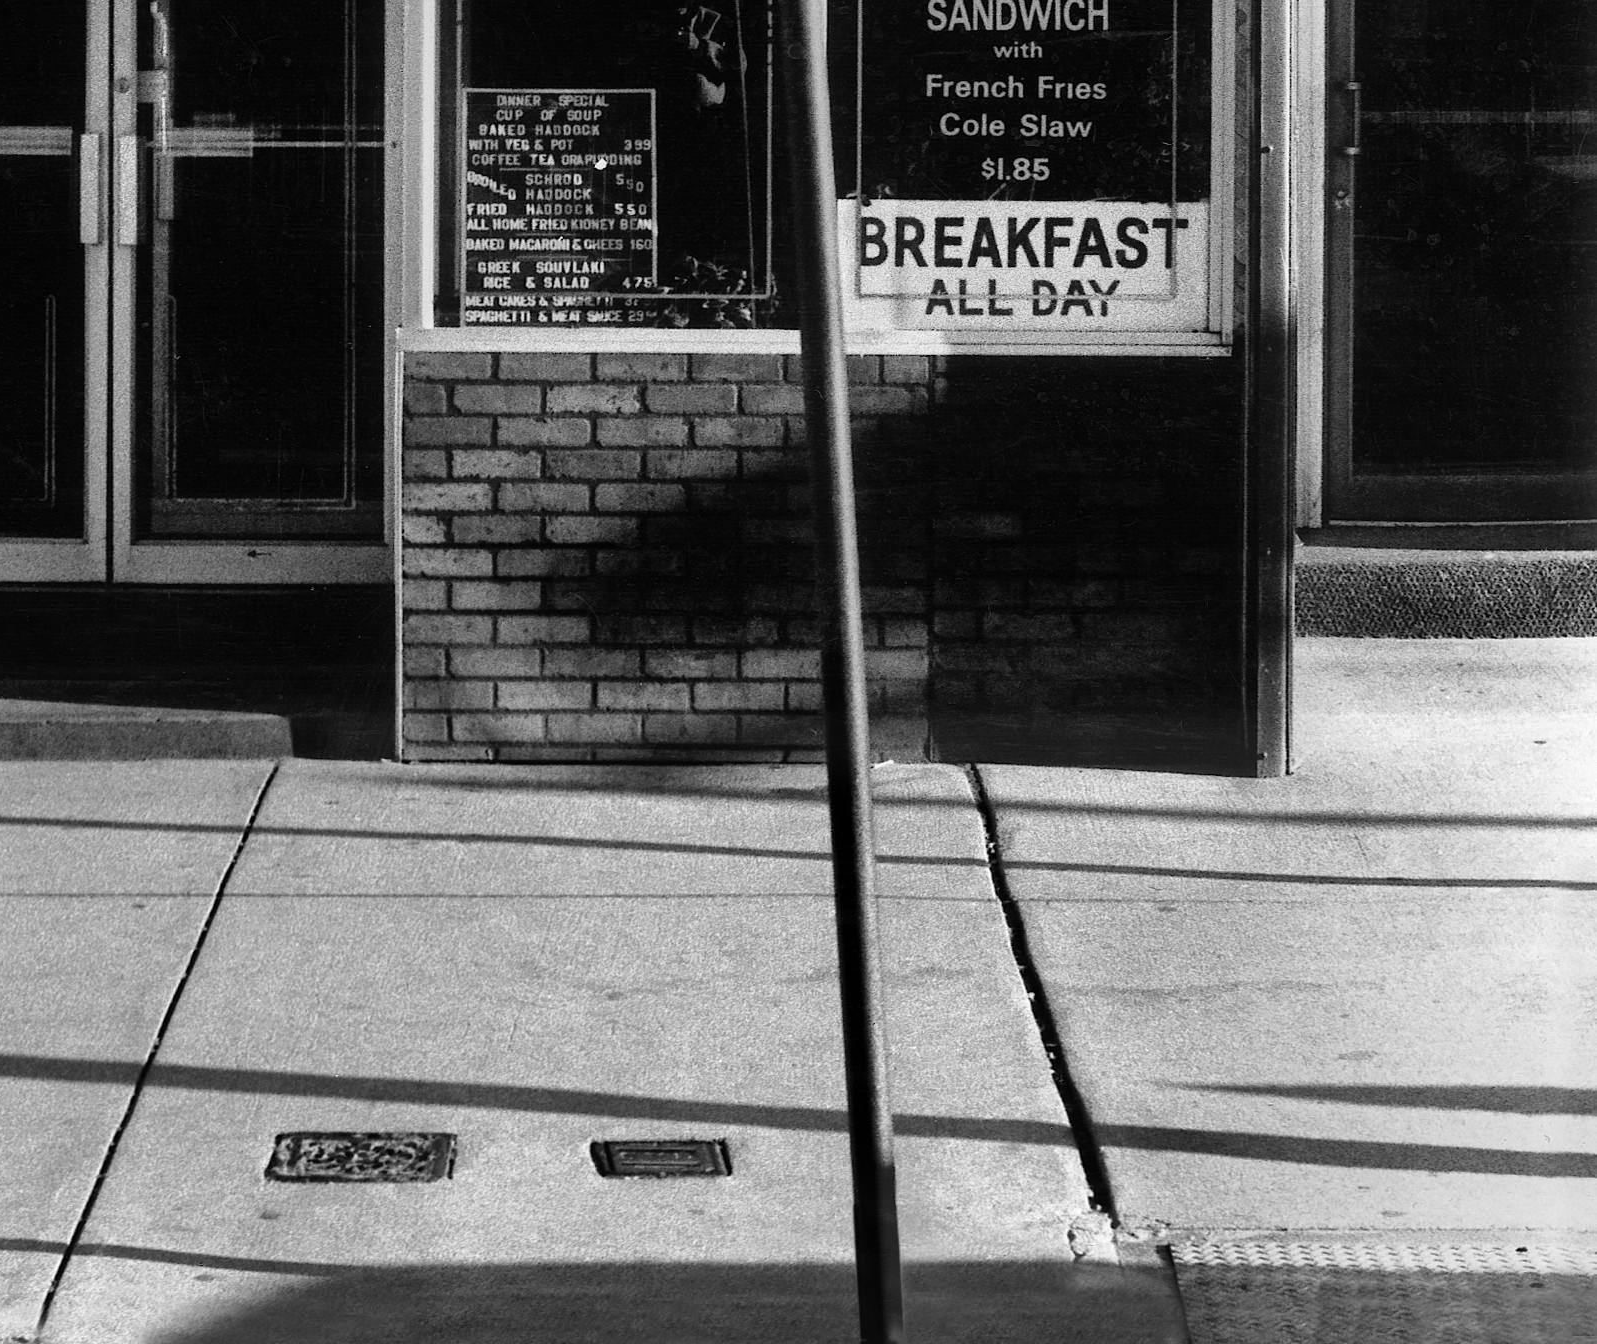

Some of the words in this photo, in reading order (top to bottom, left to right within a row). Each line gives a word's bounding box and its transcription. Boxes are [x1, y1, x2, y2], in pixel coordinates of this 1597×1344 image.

[993, 41, 1043, 58] with
[926, 74, 1024, 99] French
[1037, 76, 1107, 100] Fries
[497, 95, 541, 107] DINNER
[558, 95, 609, 107] SPECIAL
[496, 109, 524, 121] CUP
[540, 109, 557, 121] OF
[567, 109, 602, 121] SOUP
[479, 124, 525, 136] BAKED
[535, 124, 601, 136] HADDOCK
[940, 112, 1004, 137] Cole
[1020, 114, 1092, 137] Slaw
[469, 139, 498, 151] WITH
[505, 139, 530, 151] VEG
[534, 139, 544, 151] &
[551, 139, 574, 150] POT
[472, 154, 520, 166] COFFEE
[530, 154, 555, 166] TEA
[981, 158, 1050, 182] $1.85
[525, 174, 583, 186] SCHROD
[526, 189, 592, 200] HADDOCK
[467, 203, 507, 215] FRIED
[526, 203, 594, 215] HADDOCK
[466, 219, 489, 231] ALL
[492, 219, 528, 231] HOME
[532, 219, 568, 231] FRIED
[571, 219, 615, 231] KIDNEY
[620, 219, 652, 231] BEAN
[466, 239, 504, 251] BAKED
[509, 238, 570, 251] MACARONI
[572, 239, 582, 250] &
[860, 216, 1188, 269] BREAKFAST
[478, 261, 520, 273] GREEK
[536, 261, 605, 273] SOUVLAKI
[483, 276, 511, 289] RICE
[526, 276, 535, 289] &
[543, 276, 590, 289] SALAD
[465, 295, 495, 307] MEAT
[925, 278, 1013, 316] ALL
[1032, 279, 1120, 317] DAY
[466, 310, 531, 322] SPAGHETTI
[538, 310, 549, 322] &
[552, 310, 582, 322] MEAT
